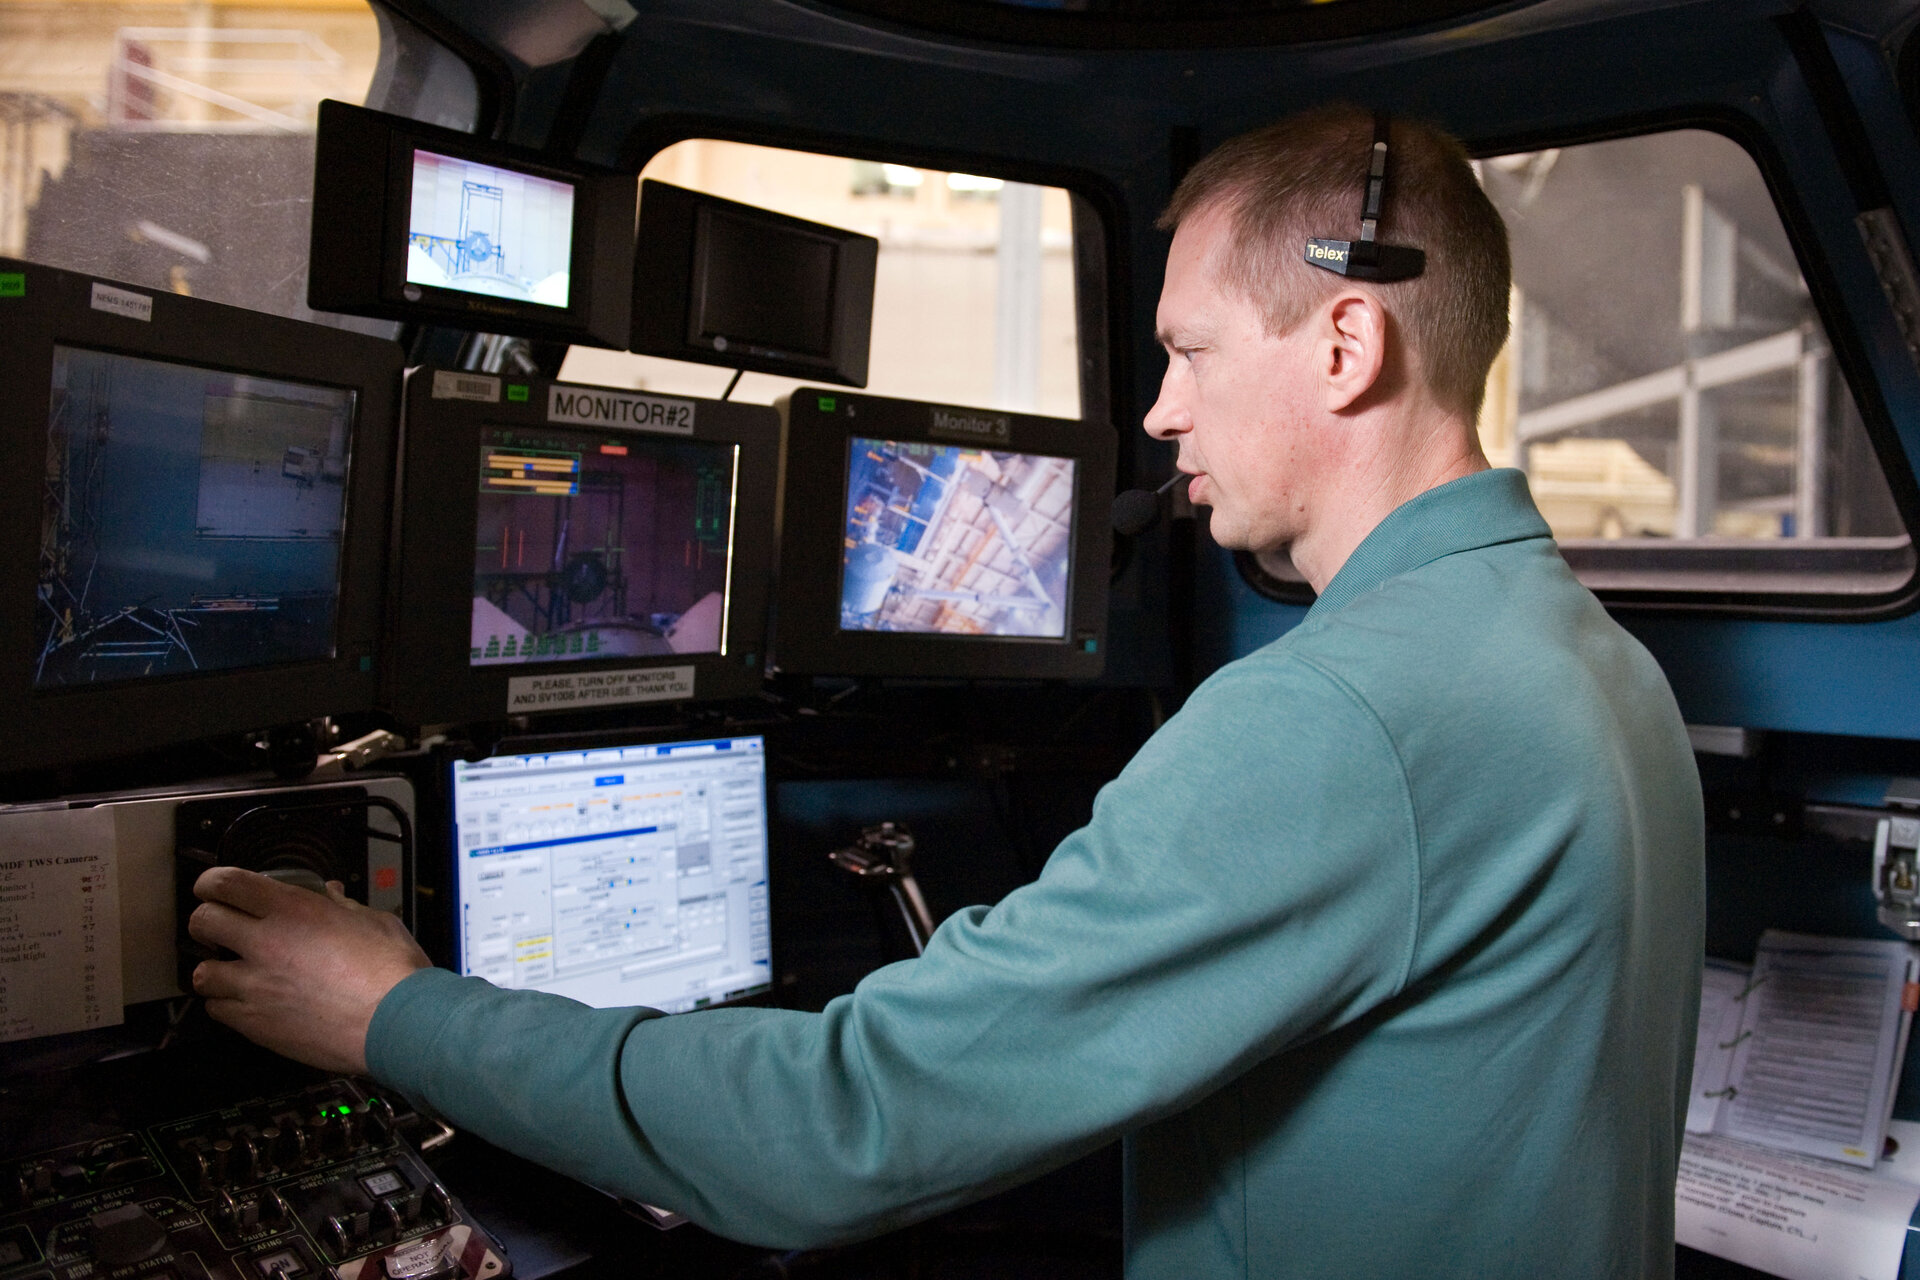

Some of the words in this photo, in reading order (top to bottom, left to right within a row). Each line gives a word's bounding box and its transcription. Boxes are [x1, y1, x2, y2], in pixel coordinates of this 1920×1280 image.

[1308, 244, 1344, 261] Telex
[554, 393, 690, 428] MONITOR#2
[934, 411, 992, 434] Monitor
[996, 418, 1007, 435] 3
[578, 676, 603, 687] TURN
[606, 674, 626, 685] OFF
[628, 671, 675, 683] MONITORS
[513, 694, 536, 705] AND
[578, 689, 609, 699] AFTER
[637, 685, 665, 695] THANK
[28, 856, 53, 868] TWS
[55, 854, 99, 866] Cameras
[172, 1218, 197, 1228] ROLL
[409, 1250, 430, 1262] NOT
